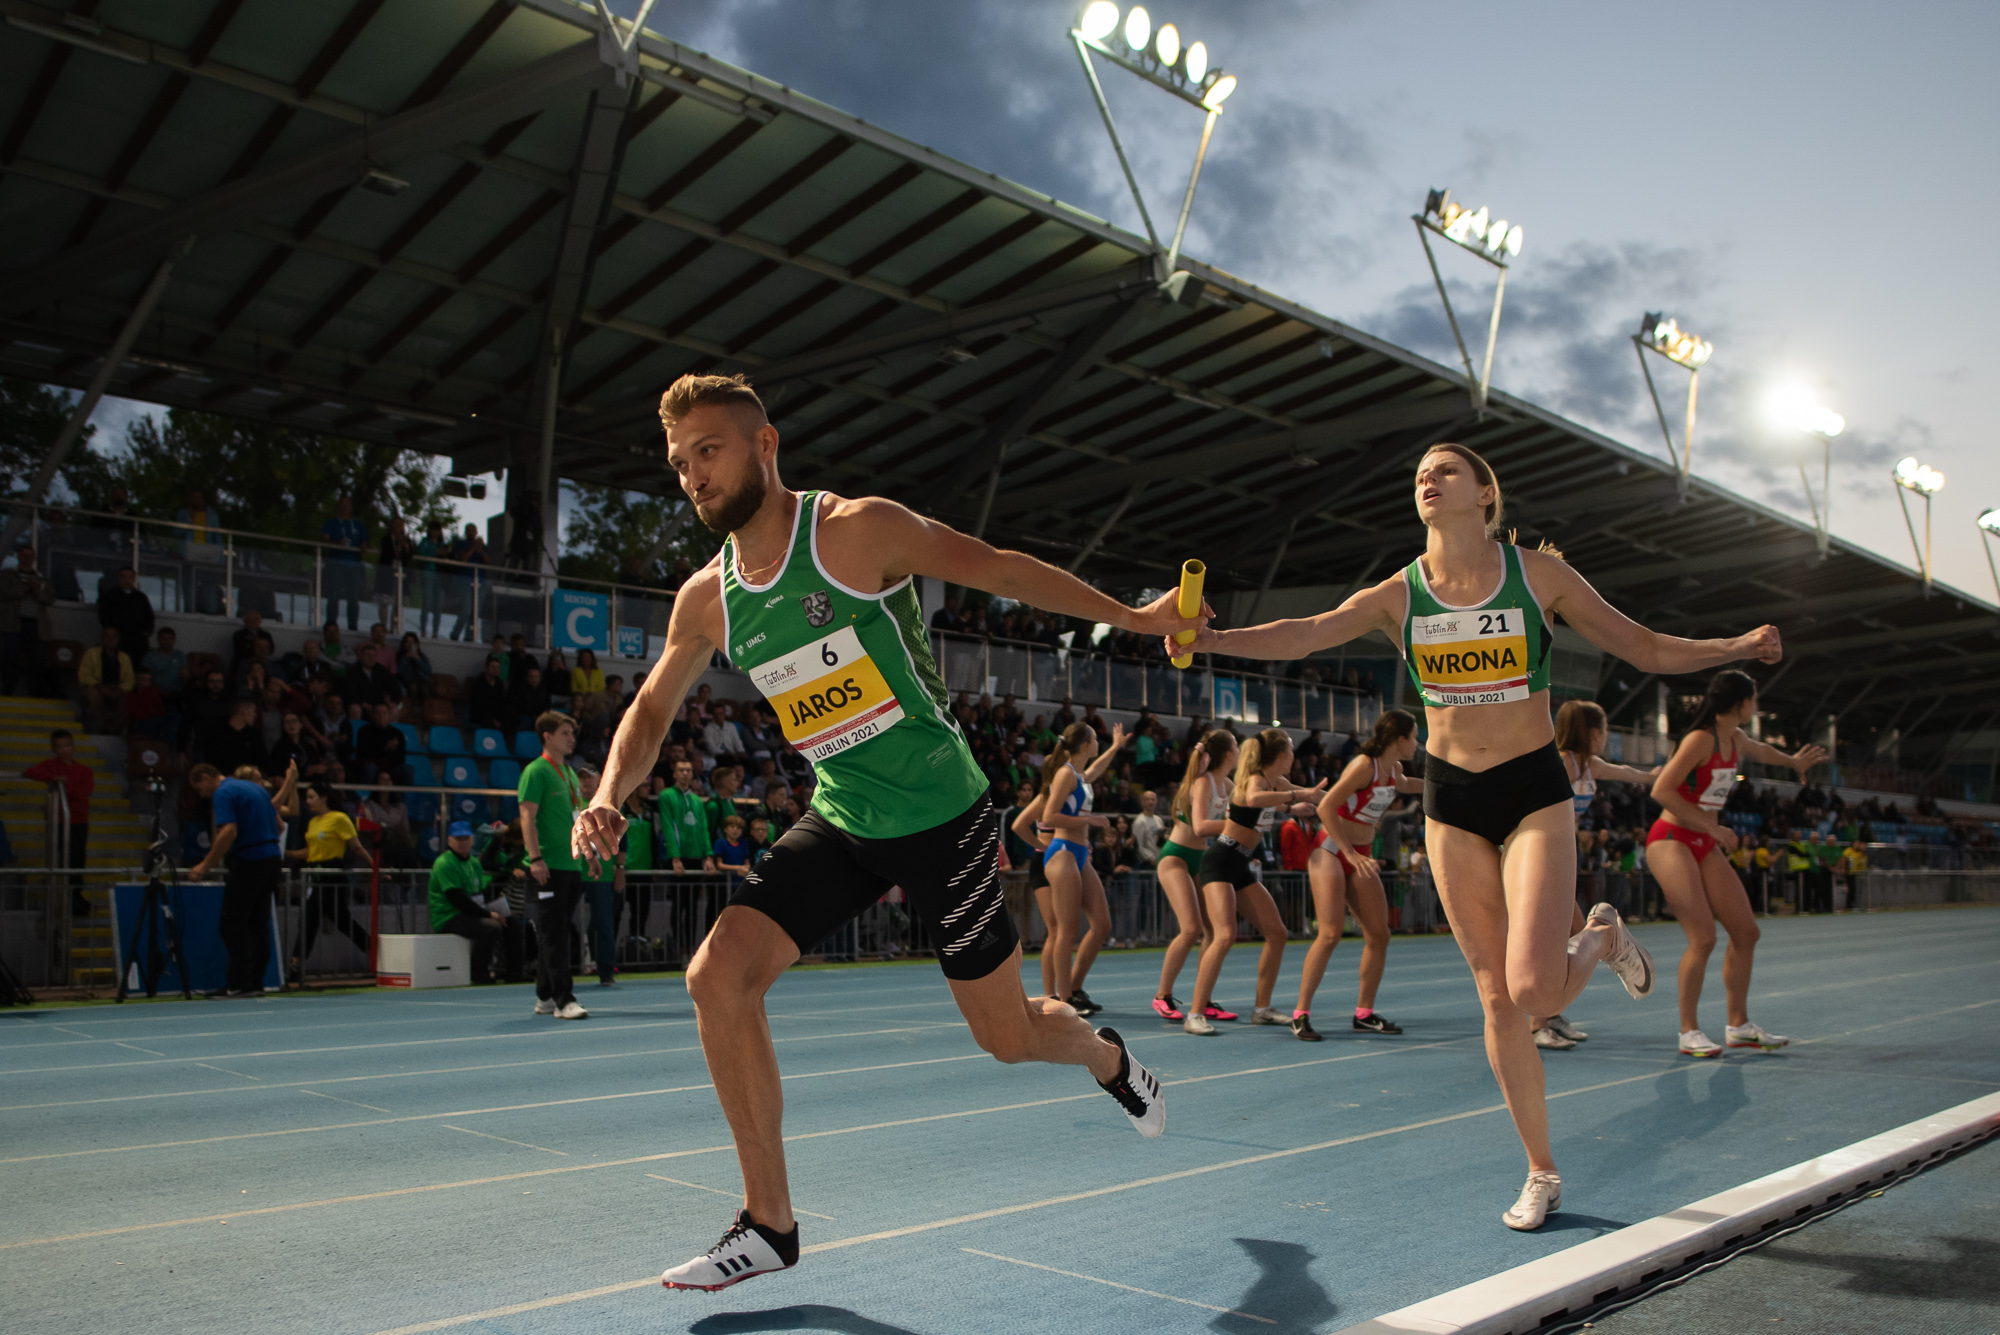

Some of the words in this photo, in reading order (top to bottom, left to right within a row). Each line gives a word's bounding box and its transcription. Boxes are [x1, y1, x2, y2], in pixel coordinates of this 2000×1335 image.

[566, 607, 595, 646] C
[1478, 613, 1510, 635] 21
[620, 631, 641, 645] WC
[746, 632, 767, 648] UMCS
[821, 642, 839, 667] 6
[1422, 648, 1518, 674] WRONA
[789, 678, 863, 727] JAROS
[1221, 689, 1237, 715] D
[1442, 694, 1476, 704] LUBLIN
[1479, 692, 1505, 703] 2021
[813, 737, 850, 758] LUBLIN
[851, 722, 879, 742] 2021
